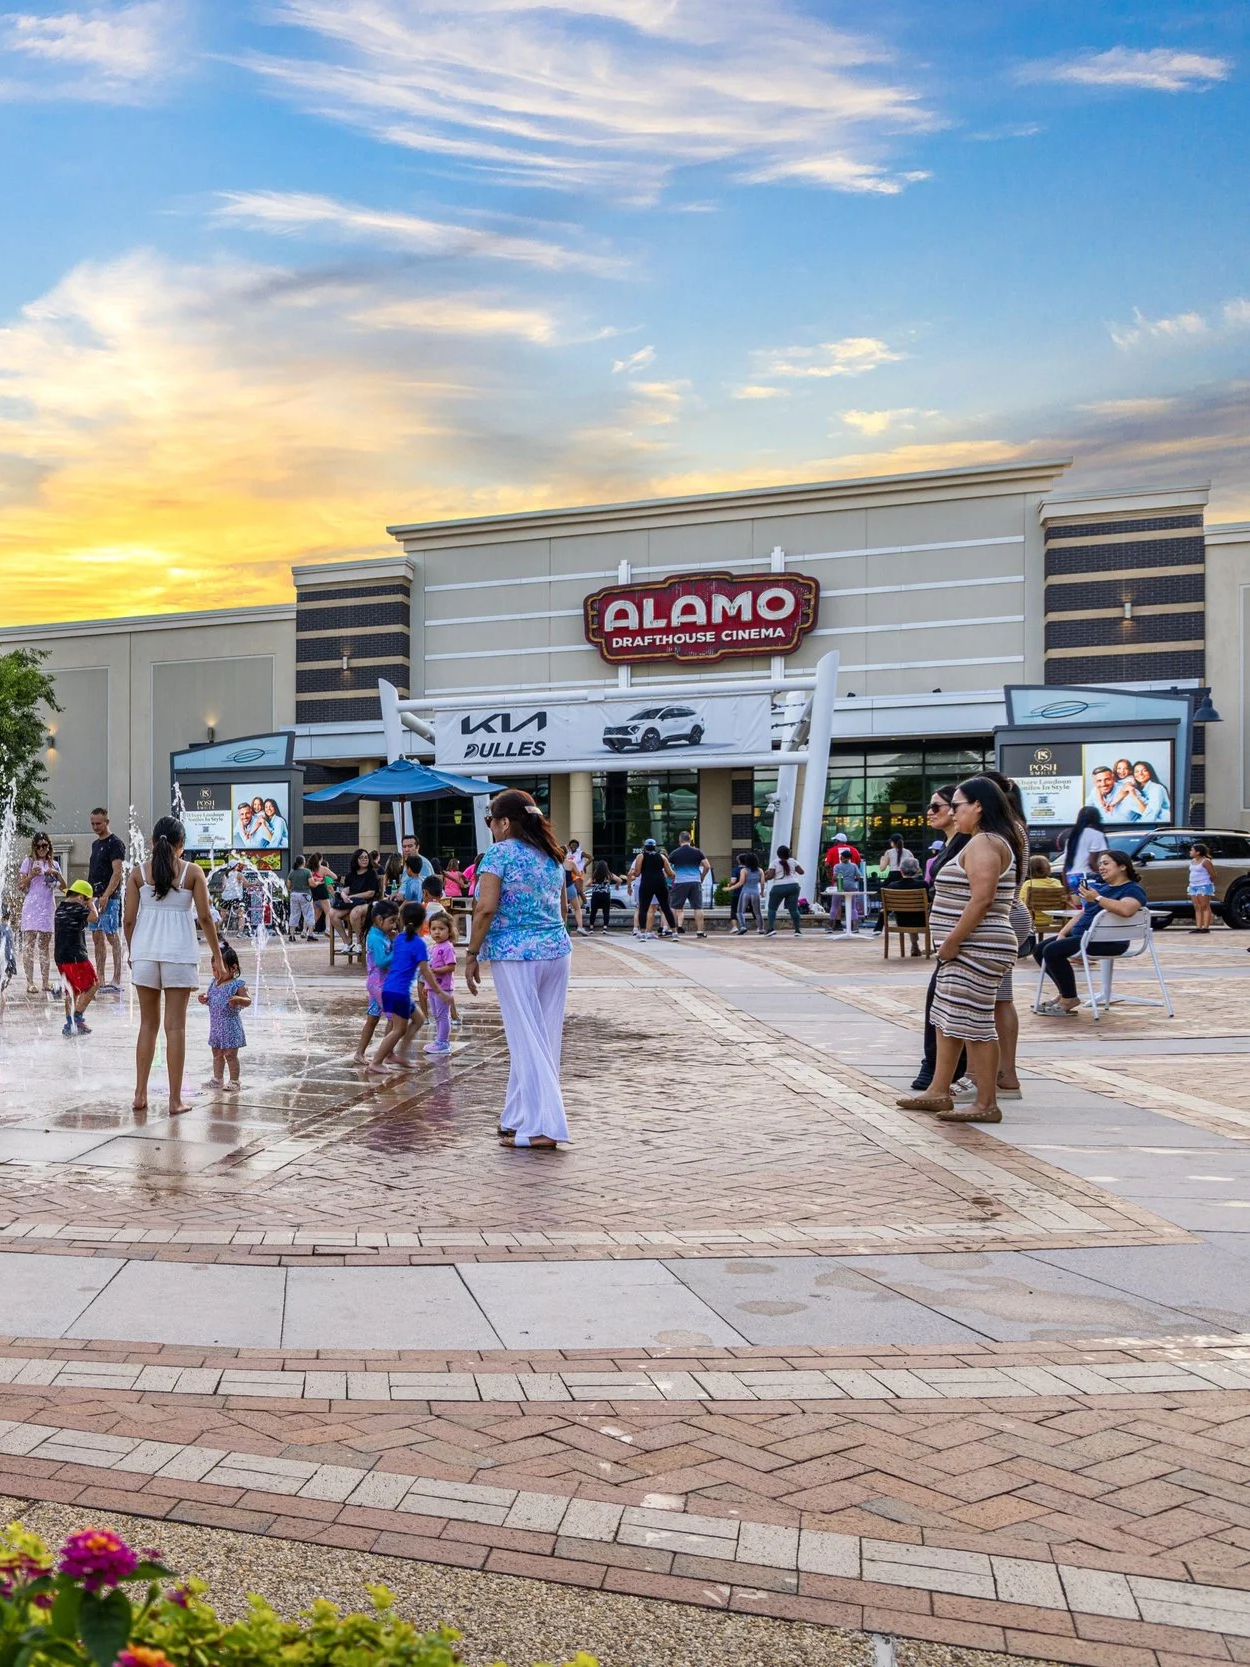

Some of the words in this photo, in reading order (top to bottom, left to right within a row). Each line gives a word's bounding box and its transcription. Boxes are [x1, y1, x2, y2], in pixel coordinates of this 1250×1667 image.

[604, 587, 796, 631] ALAMO
[613, 631, 715, 648] DRAFTHOUSE
[721, 627, 786, 641] CINEMA
[461, 711, 547, 735] KIA
[464, 740, 546, 759] DULLES
